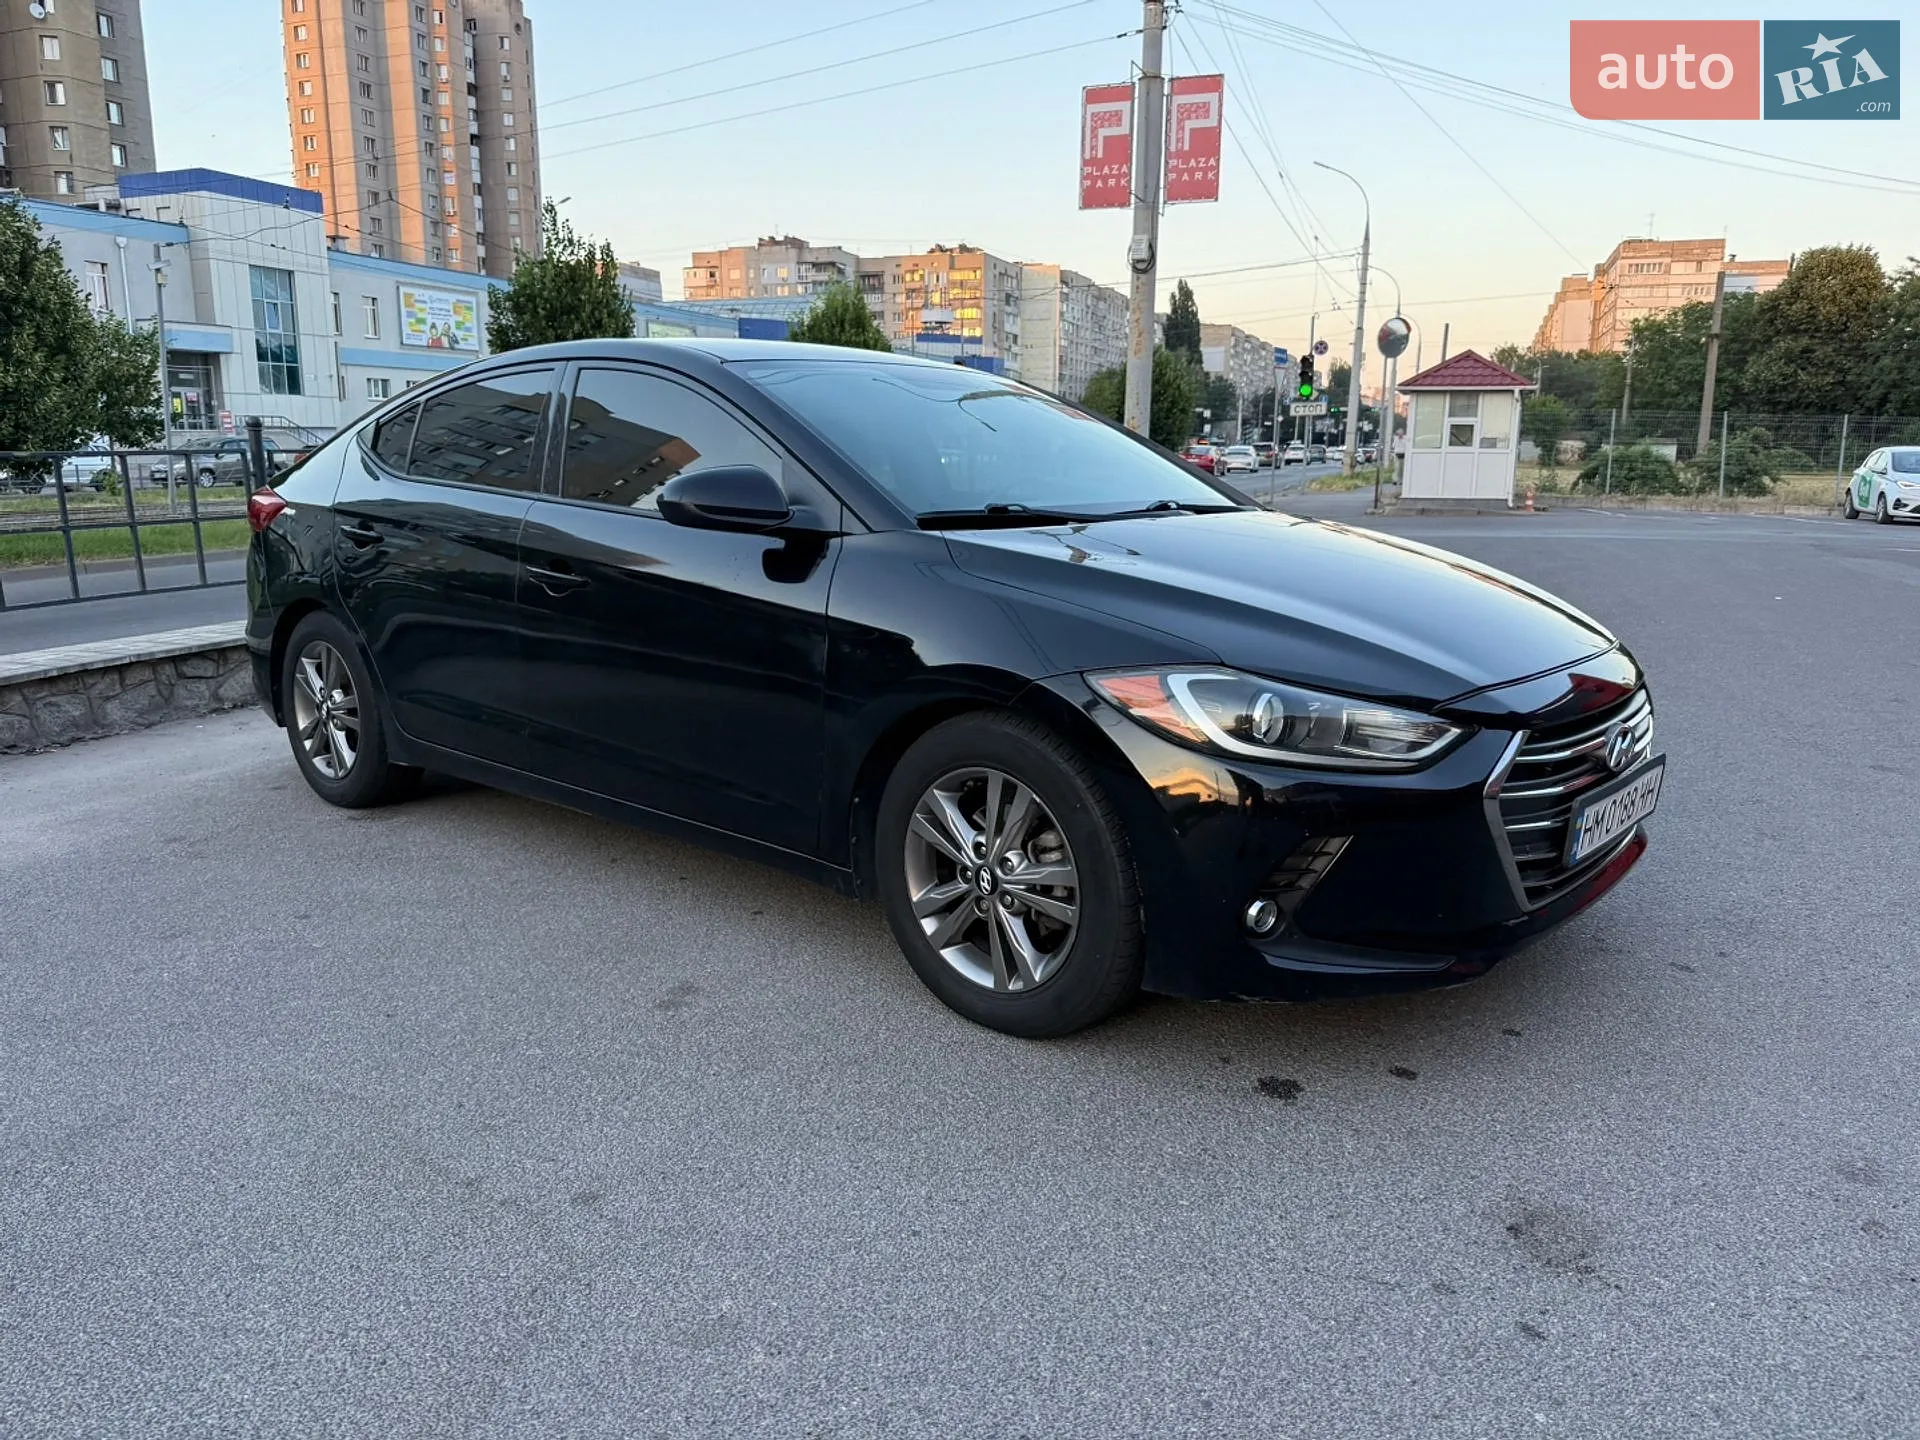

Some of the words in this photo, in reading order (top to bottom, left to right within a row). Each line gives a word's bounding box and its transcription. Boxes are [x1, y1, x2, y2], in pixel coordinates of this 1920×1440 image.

[1168, 157, 1217, 168] PLAZA
[1084, 164, 1128, 175] PLAZA
[1168, 170, 1217, 181] PARK
[1083, 177, 1129, 188] PARK
[1294, 404, 1322, 413] СТОП
